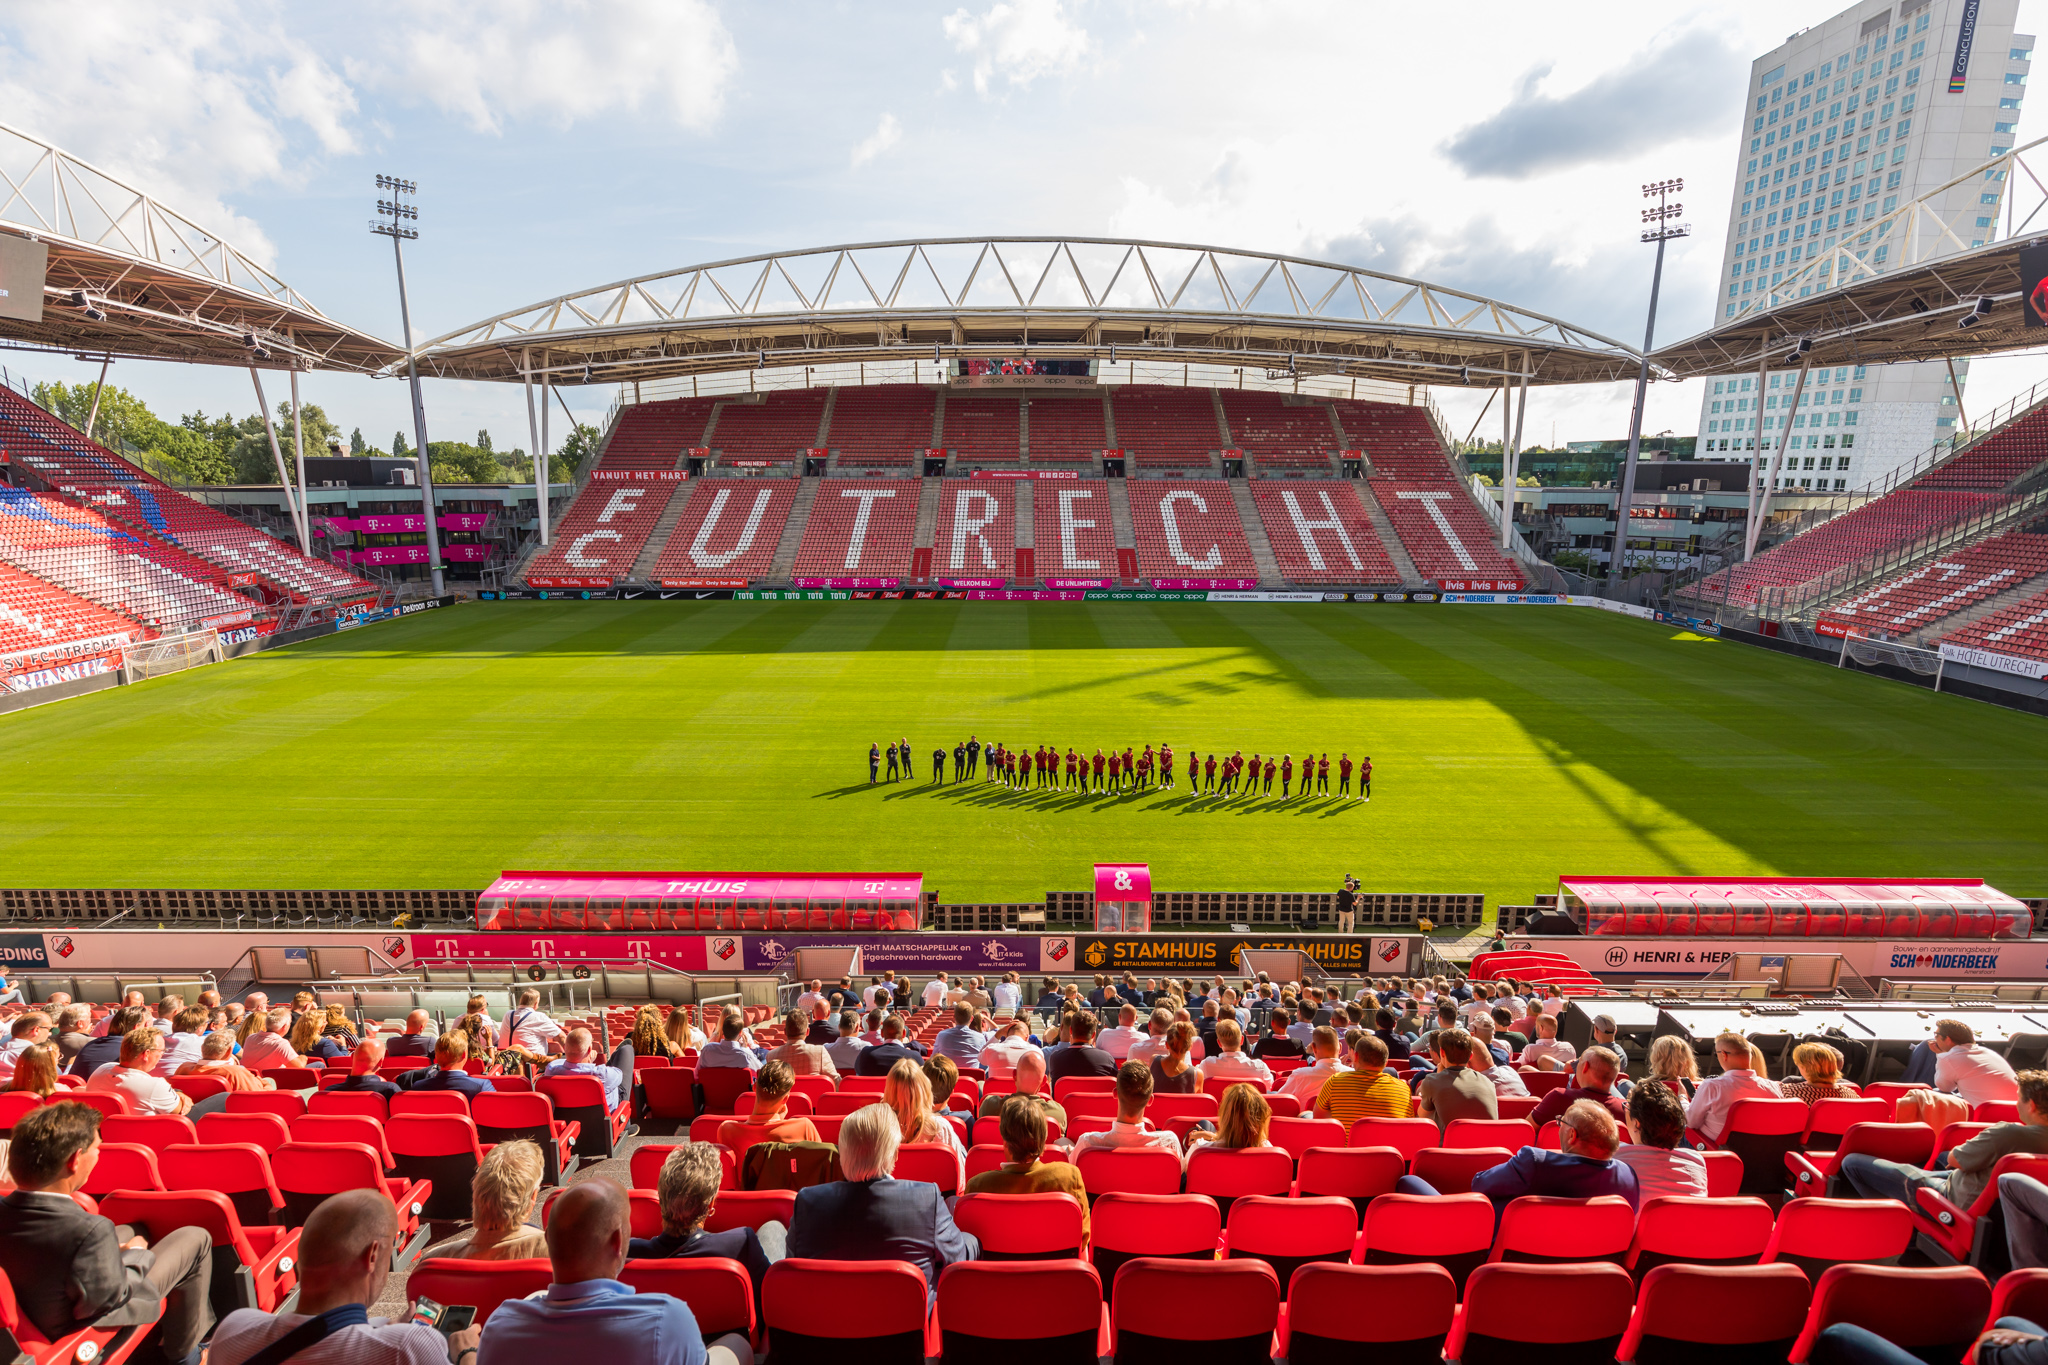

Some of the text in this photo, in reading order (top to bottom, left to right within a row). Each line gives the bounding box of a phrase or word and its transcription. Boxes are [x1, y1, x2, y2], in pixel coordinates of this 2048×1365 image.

[1956, 1, 1978, 73] CONCLUSION
[593, 471, 687, 479] VANUIT HET HART
[597, 488, 646, 522] F
[1655, 555, 1692, 565] oppo
[1445, 581, 1465, 590] livis
[1471, 581, 1491, 590] livis
[1497, 581, 1517, 590] livis
[1820, 624, 1845, 635] Only for
[3, 638, 118, 670] SV FC UTRECHT
[1956, 649, 1988, 666] HOTEL
[1990, 655, 2041, 676] UTRECHT
[1114, 870, 1133, 891] &
[666, 881, 748, 894] THUIS
[882, 944, 958, 952] MAATSCHAPPELIJK
[1113, 942, 1217, 959] STAMHUIS
[1930, 945, 2002, 955] aannemingsbedrijf
[862, 953, 962, 963] afgeschreven hardware
[1633, 952, 1680, 963] HENRI
[1684, 952, 1695, 963] &
[81, 1344, 95, 1358] 23
